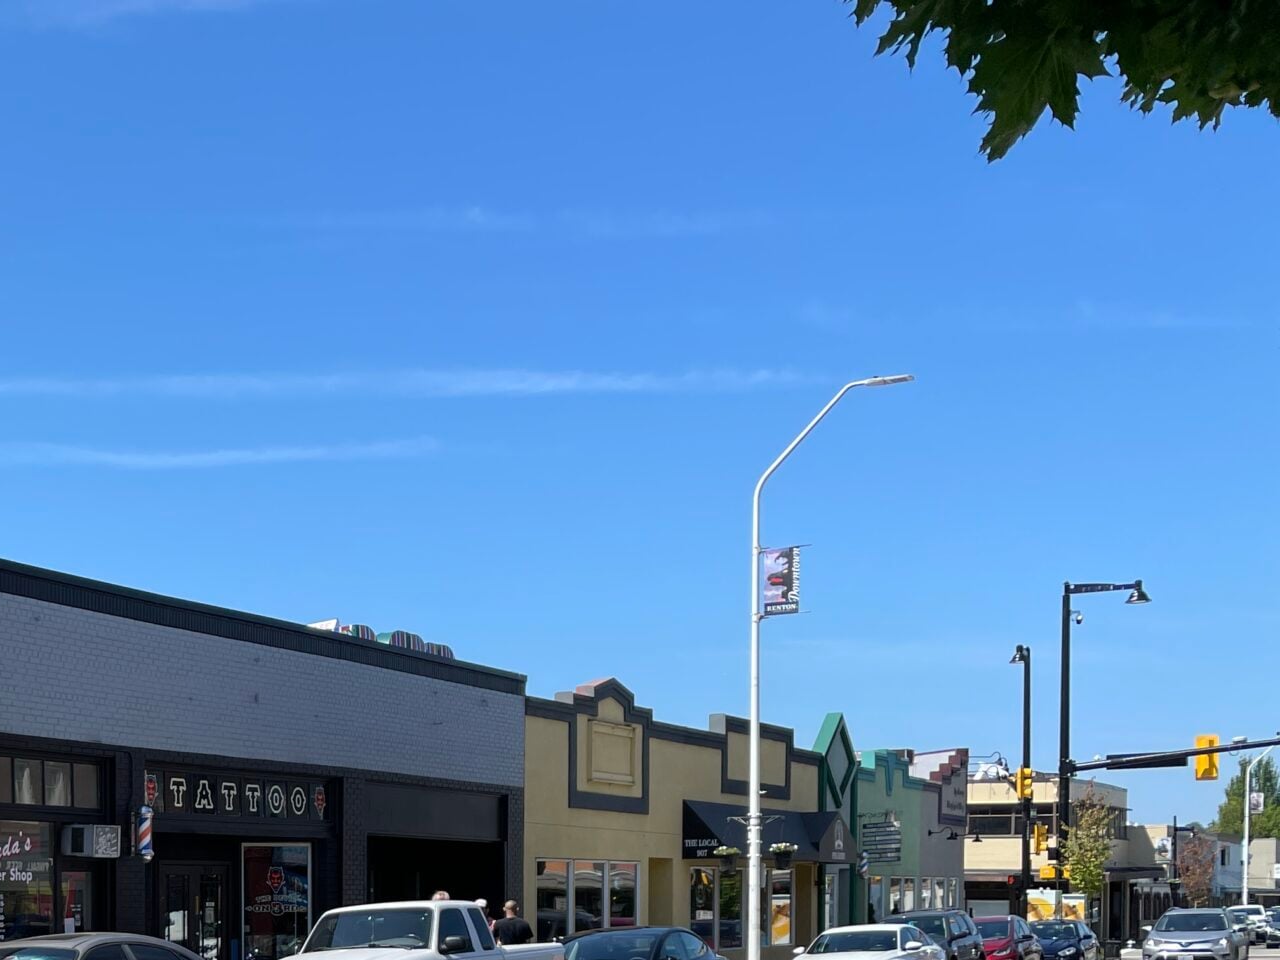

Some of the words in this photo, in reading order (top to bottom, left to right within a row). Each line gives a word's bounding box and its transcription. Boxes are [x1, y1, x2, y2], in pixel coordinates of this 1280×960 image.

[766, 603, 797, 612] RENTON
[170, 777, 307, 815] TATTOO
[684, 839, 698, 847] THE
[698, 839, 719, 847] LOCAL
[9, 867, 33, 885] Shop
